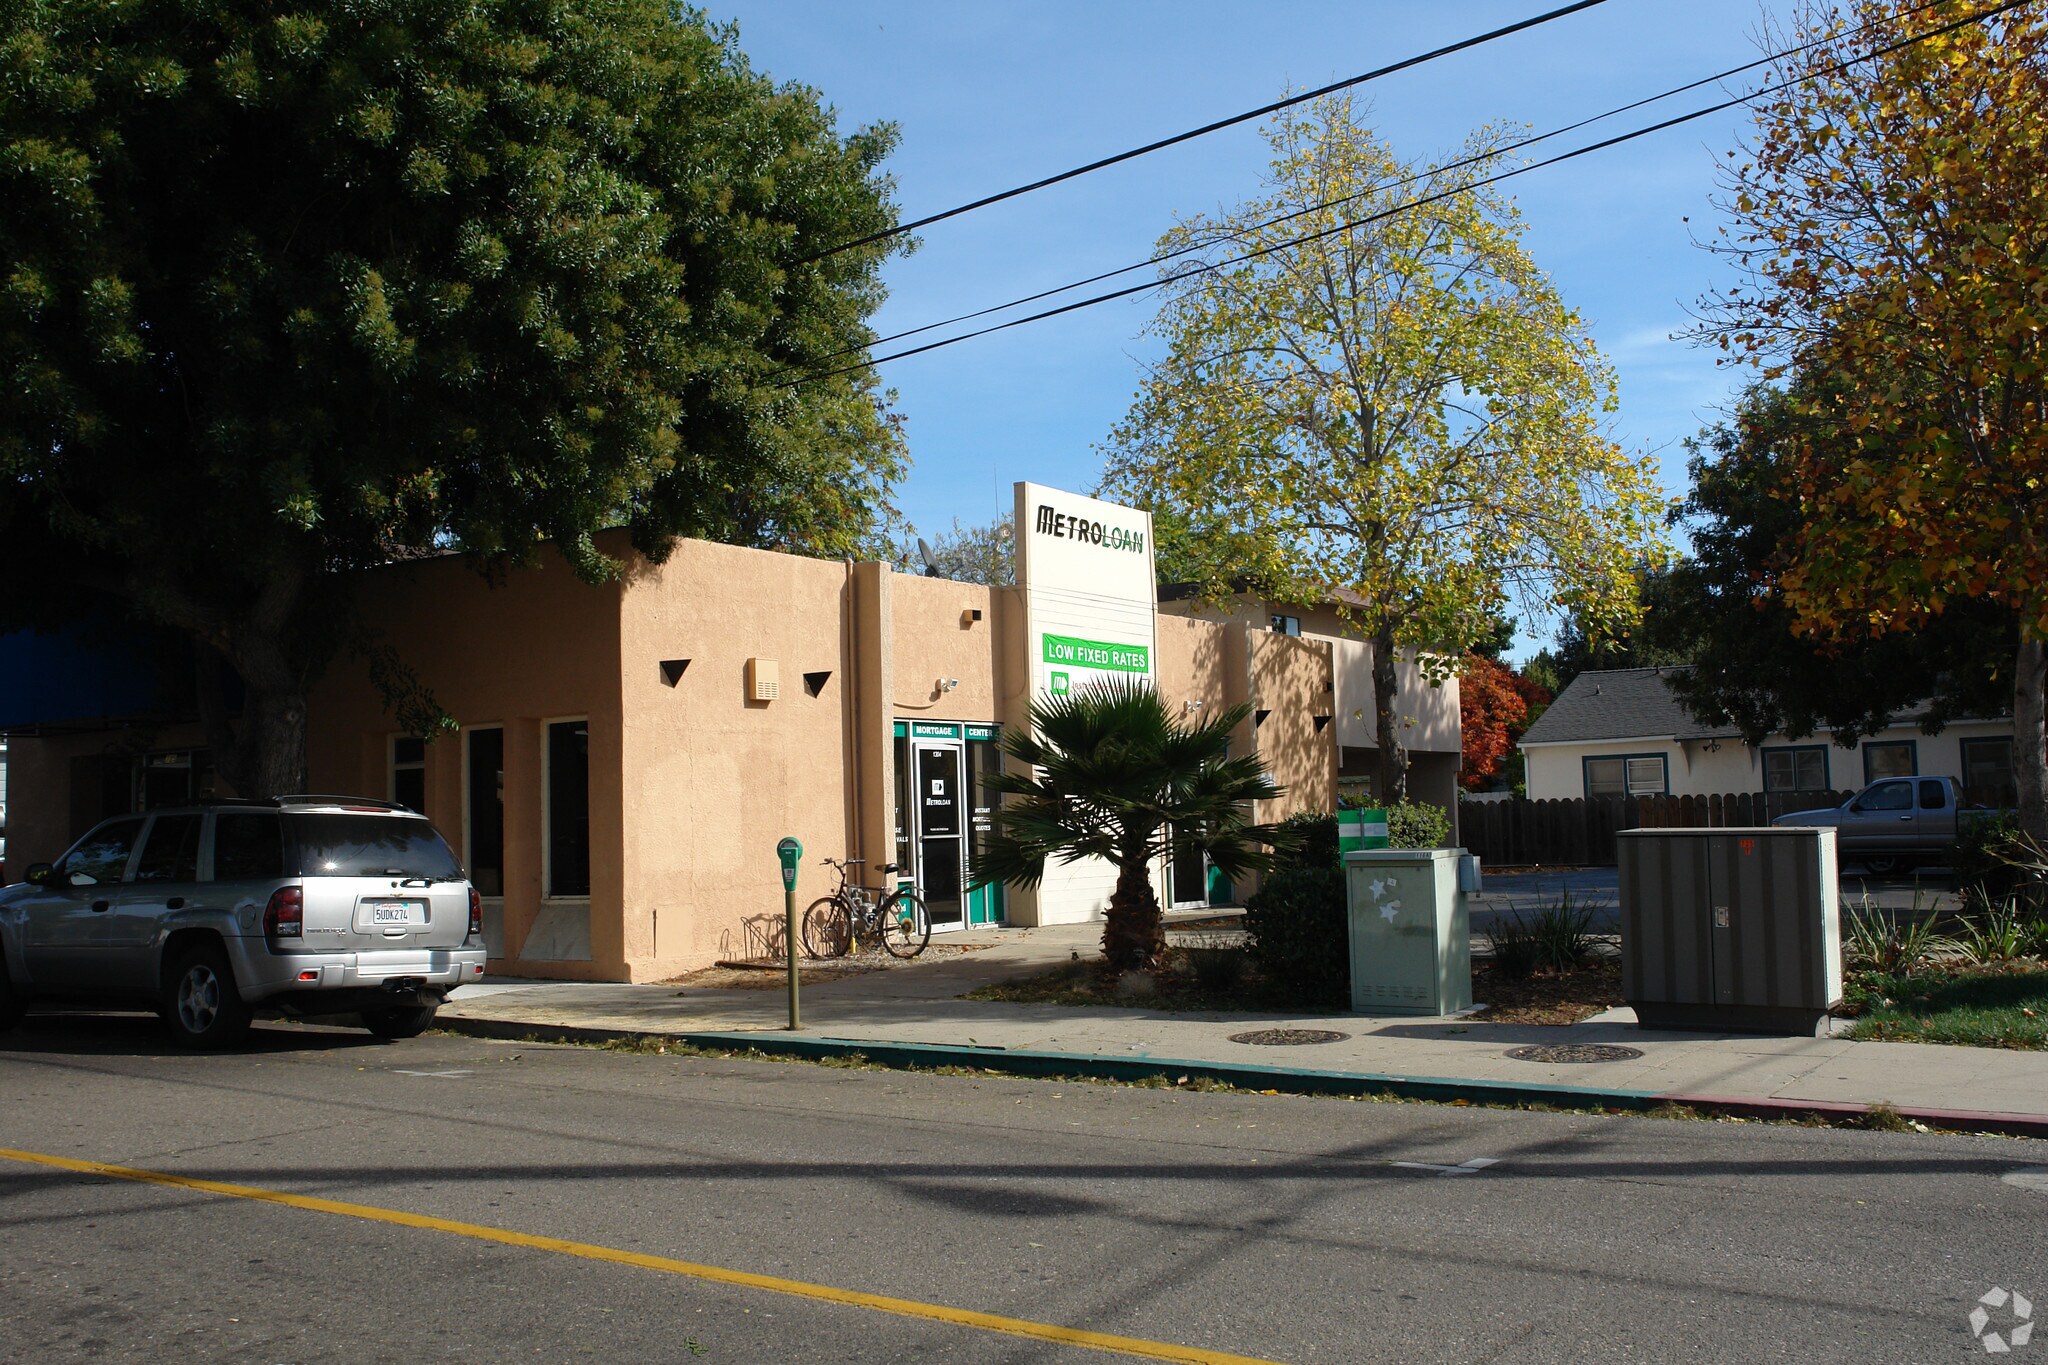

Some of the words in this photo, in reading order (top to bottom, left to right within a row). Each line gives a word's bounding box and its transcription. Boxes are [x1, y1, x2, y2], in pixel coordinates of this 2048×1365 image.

[1036, 505, 1144, 554] METROLOAN
[1048, 642, 1075, 660] LOW
[1077, 646, 1109, 665] FIXED
[1112, 650, 1146, 668] RATES
[916, 726, 952, 735] MORTGAGE
[968, 728, 993, 737] CENTER
[376, 909, 408, 920] 5UDK274
